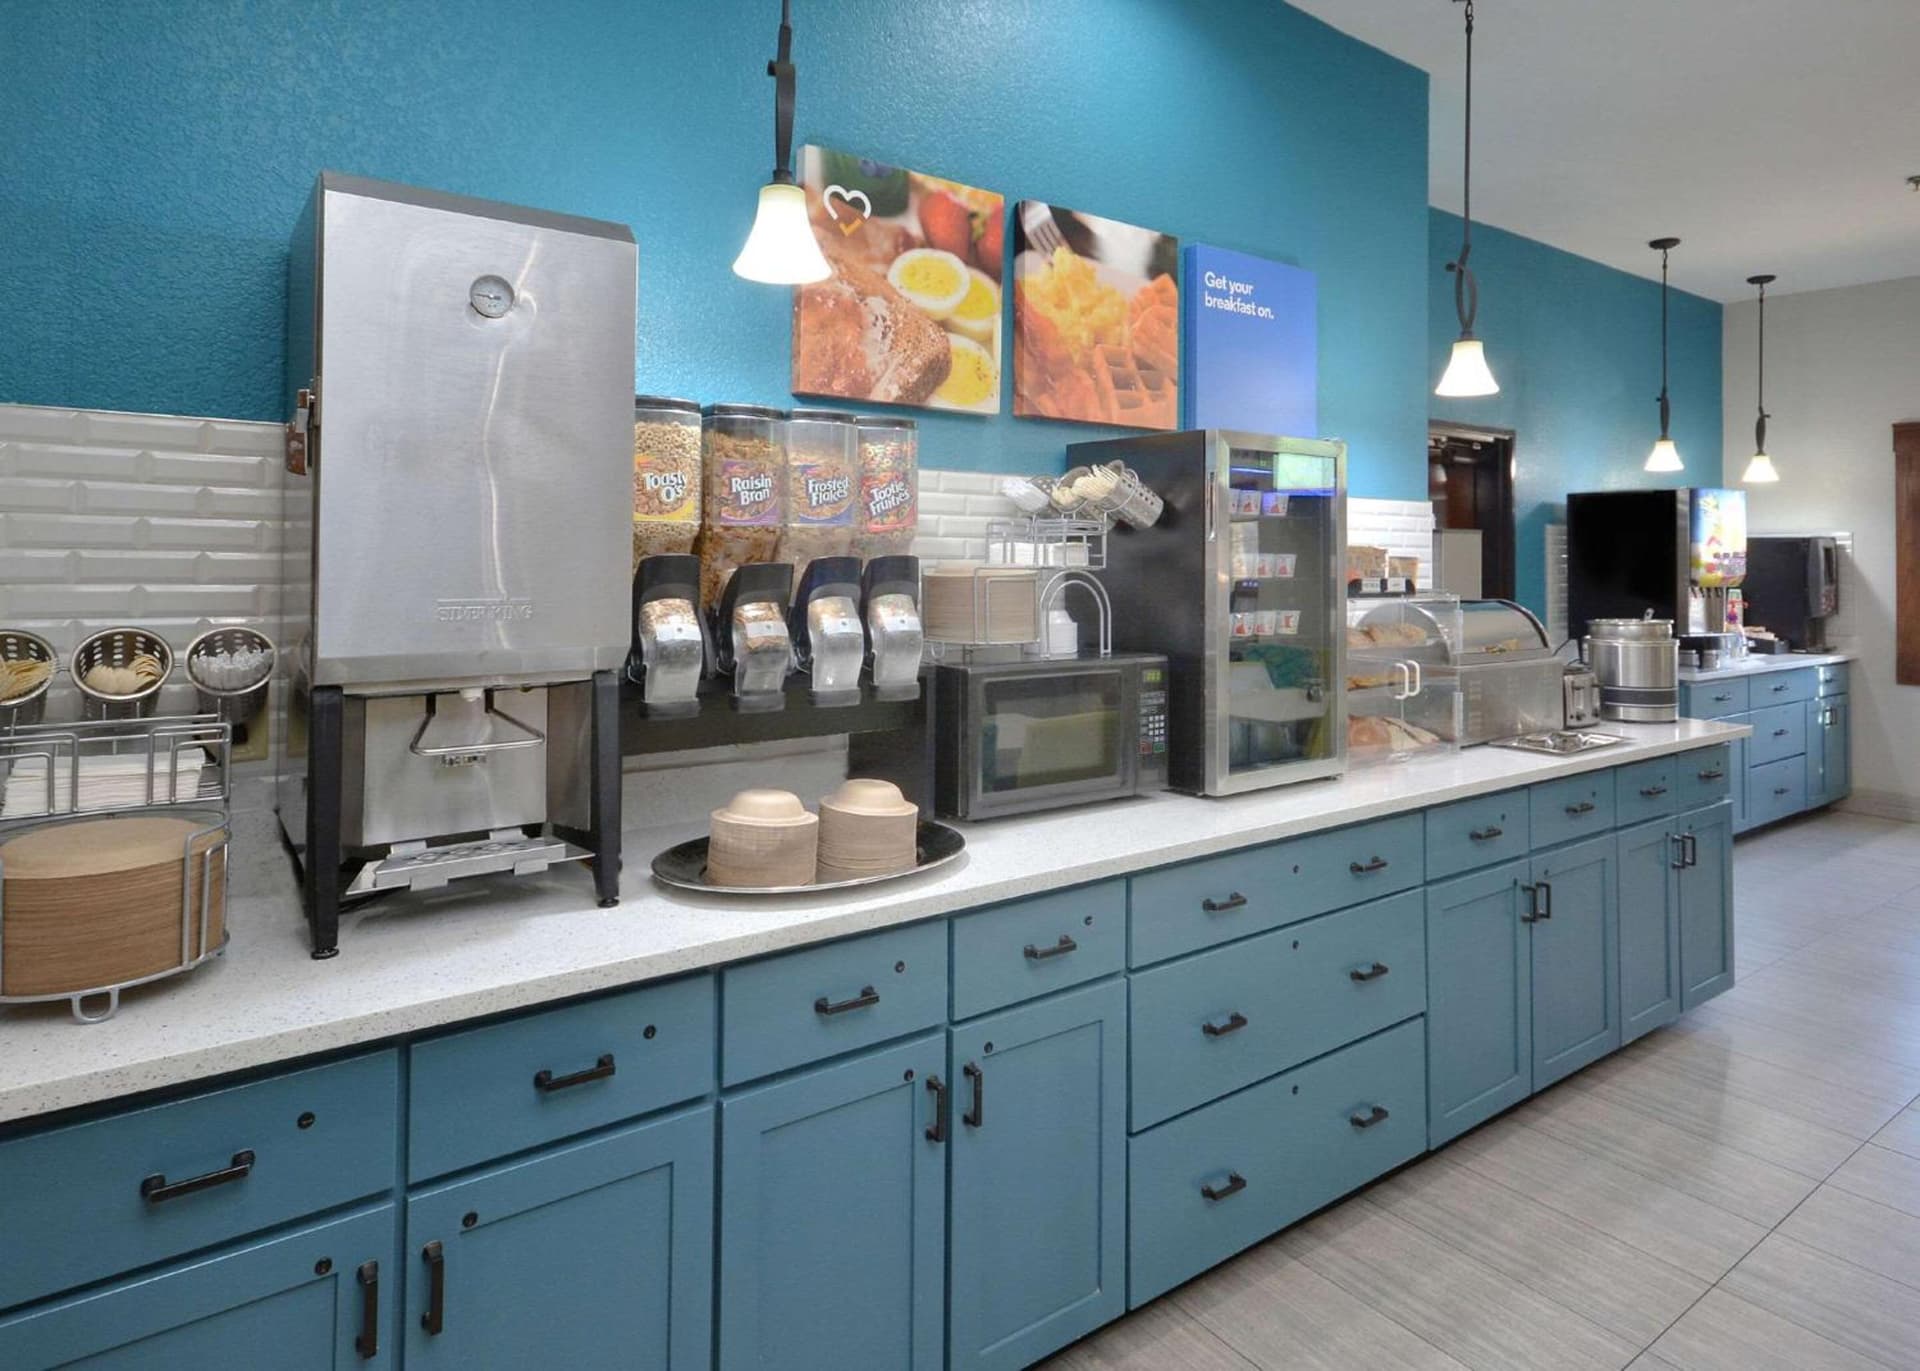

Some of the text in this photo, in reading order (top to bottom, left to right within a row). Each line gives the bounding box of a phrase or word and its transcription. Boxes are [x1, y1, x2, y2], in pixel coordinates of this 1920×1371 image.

[1204, 271, 1254, 296] Get your
[1204, 291, 1275, 319] breakfast on.
[642, 470, 687, 490] Toasty
[731, 474, 773, 493] Raisin
[807, 476, 849, 494] Frosted
[740, 488, 770, 506] Bran
[811, 488, 848, 507] Flakes
[870, 481, 905, 501] Tootie
[869, 490, 910, 516] Fruities
